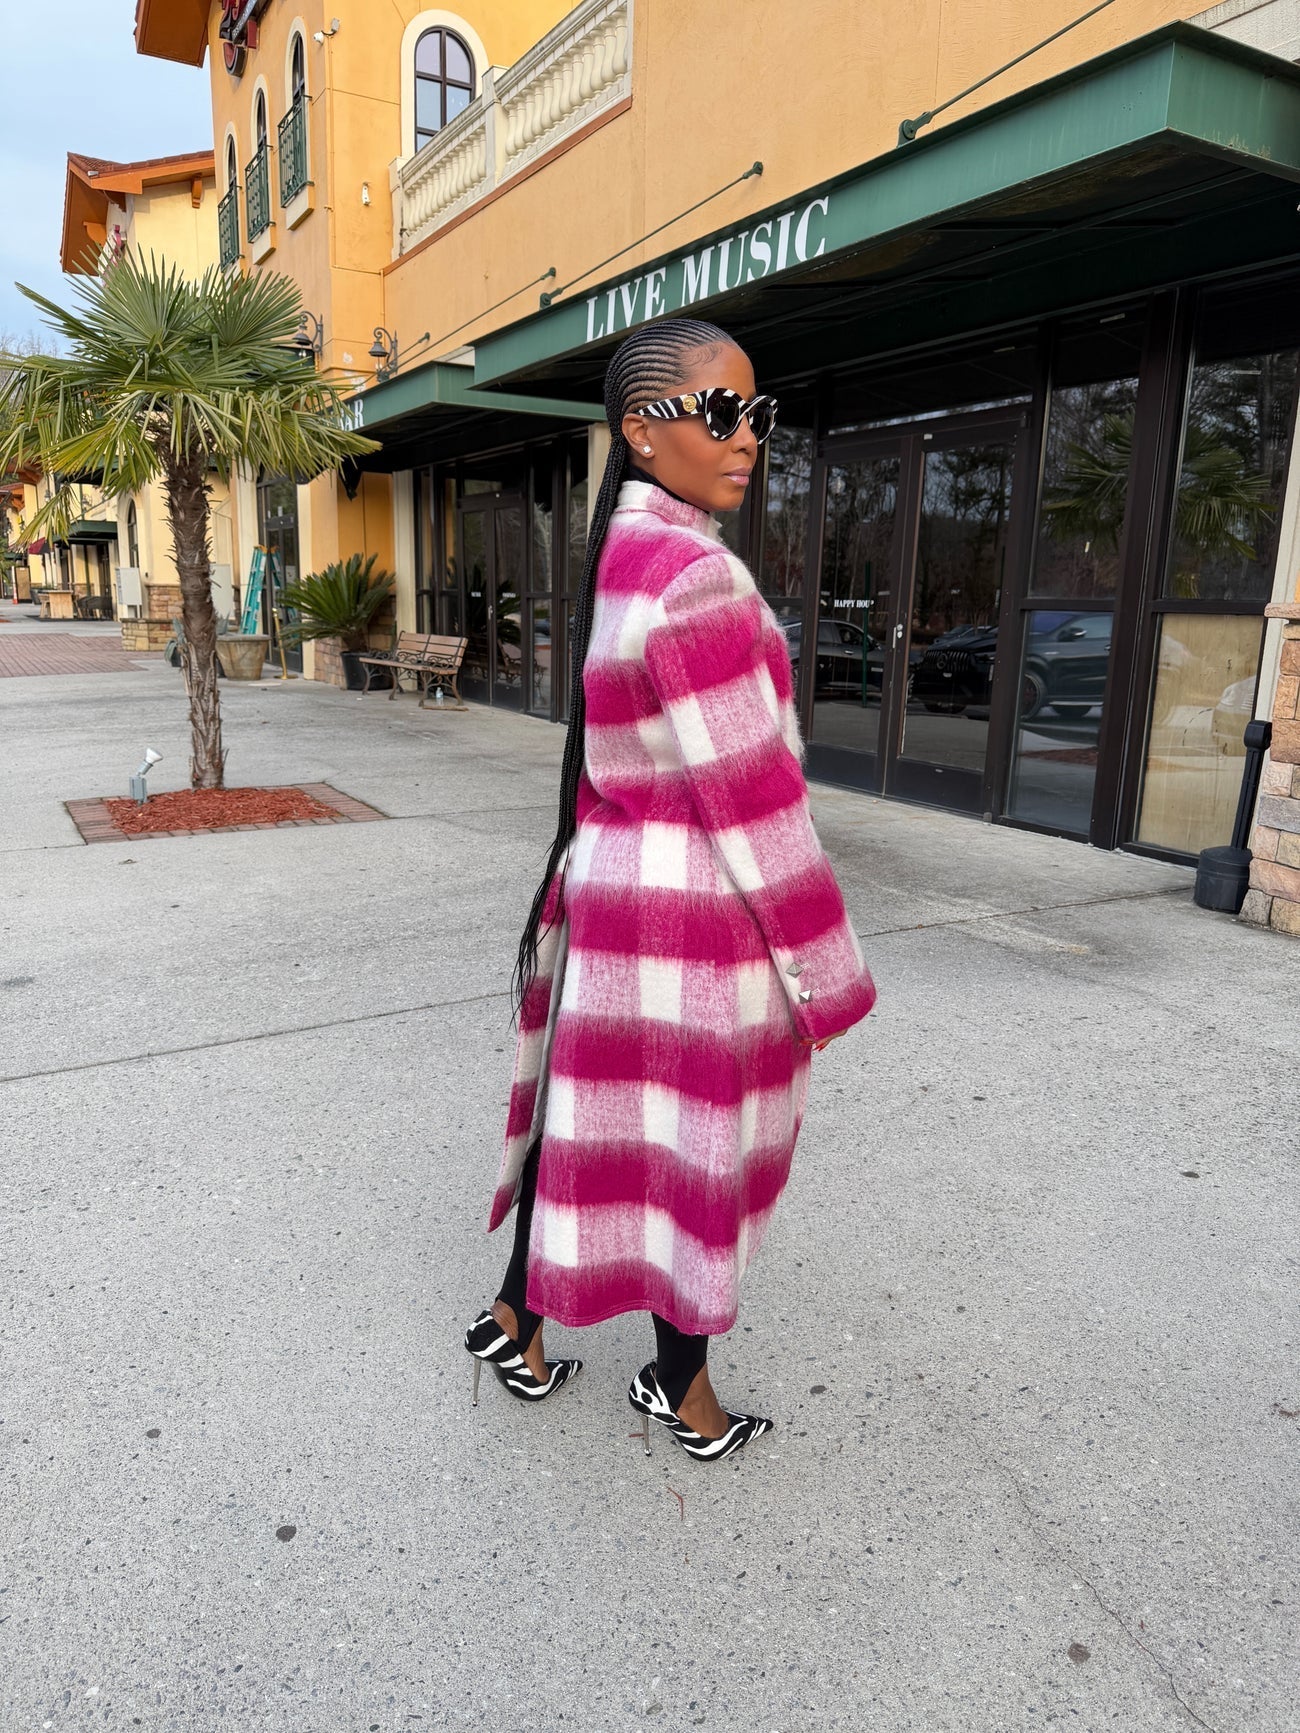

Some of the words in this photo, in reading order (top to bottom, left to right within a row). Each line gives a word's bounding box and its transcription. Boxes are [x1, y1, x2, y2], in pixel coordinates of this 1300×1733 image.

[585, 267, 666, 343] LIVE
[681, 196, 829, 307] MUSIC
[834, 599, 855, 608] HAPPY
